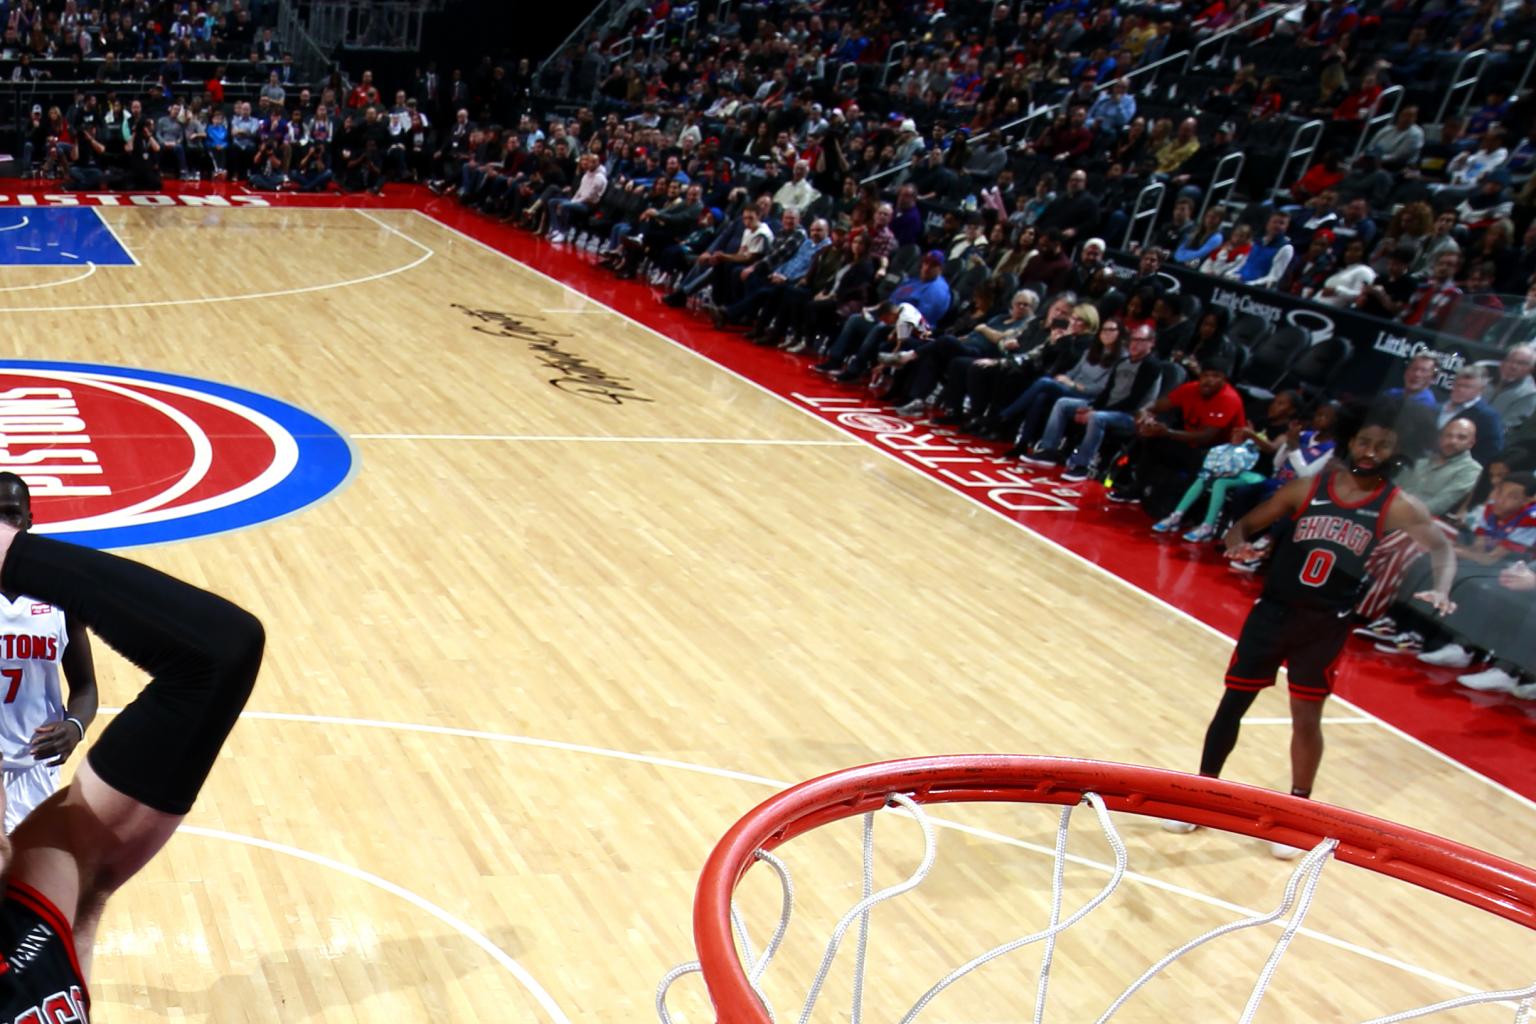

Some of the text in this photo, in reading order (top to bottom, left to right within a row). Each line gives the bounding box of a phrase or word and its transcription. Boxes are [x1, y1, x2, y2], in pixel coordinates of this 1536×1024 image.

[1373, 331, 1411, 358] Little
[1292, 515, 1373, 556] CHICAGO
[1299, 548, 1337, 588] 0
[0, 668, 23, 704] 7
